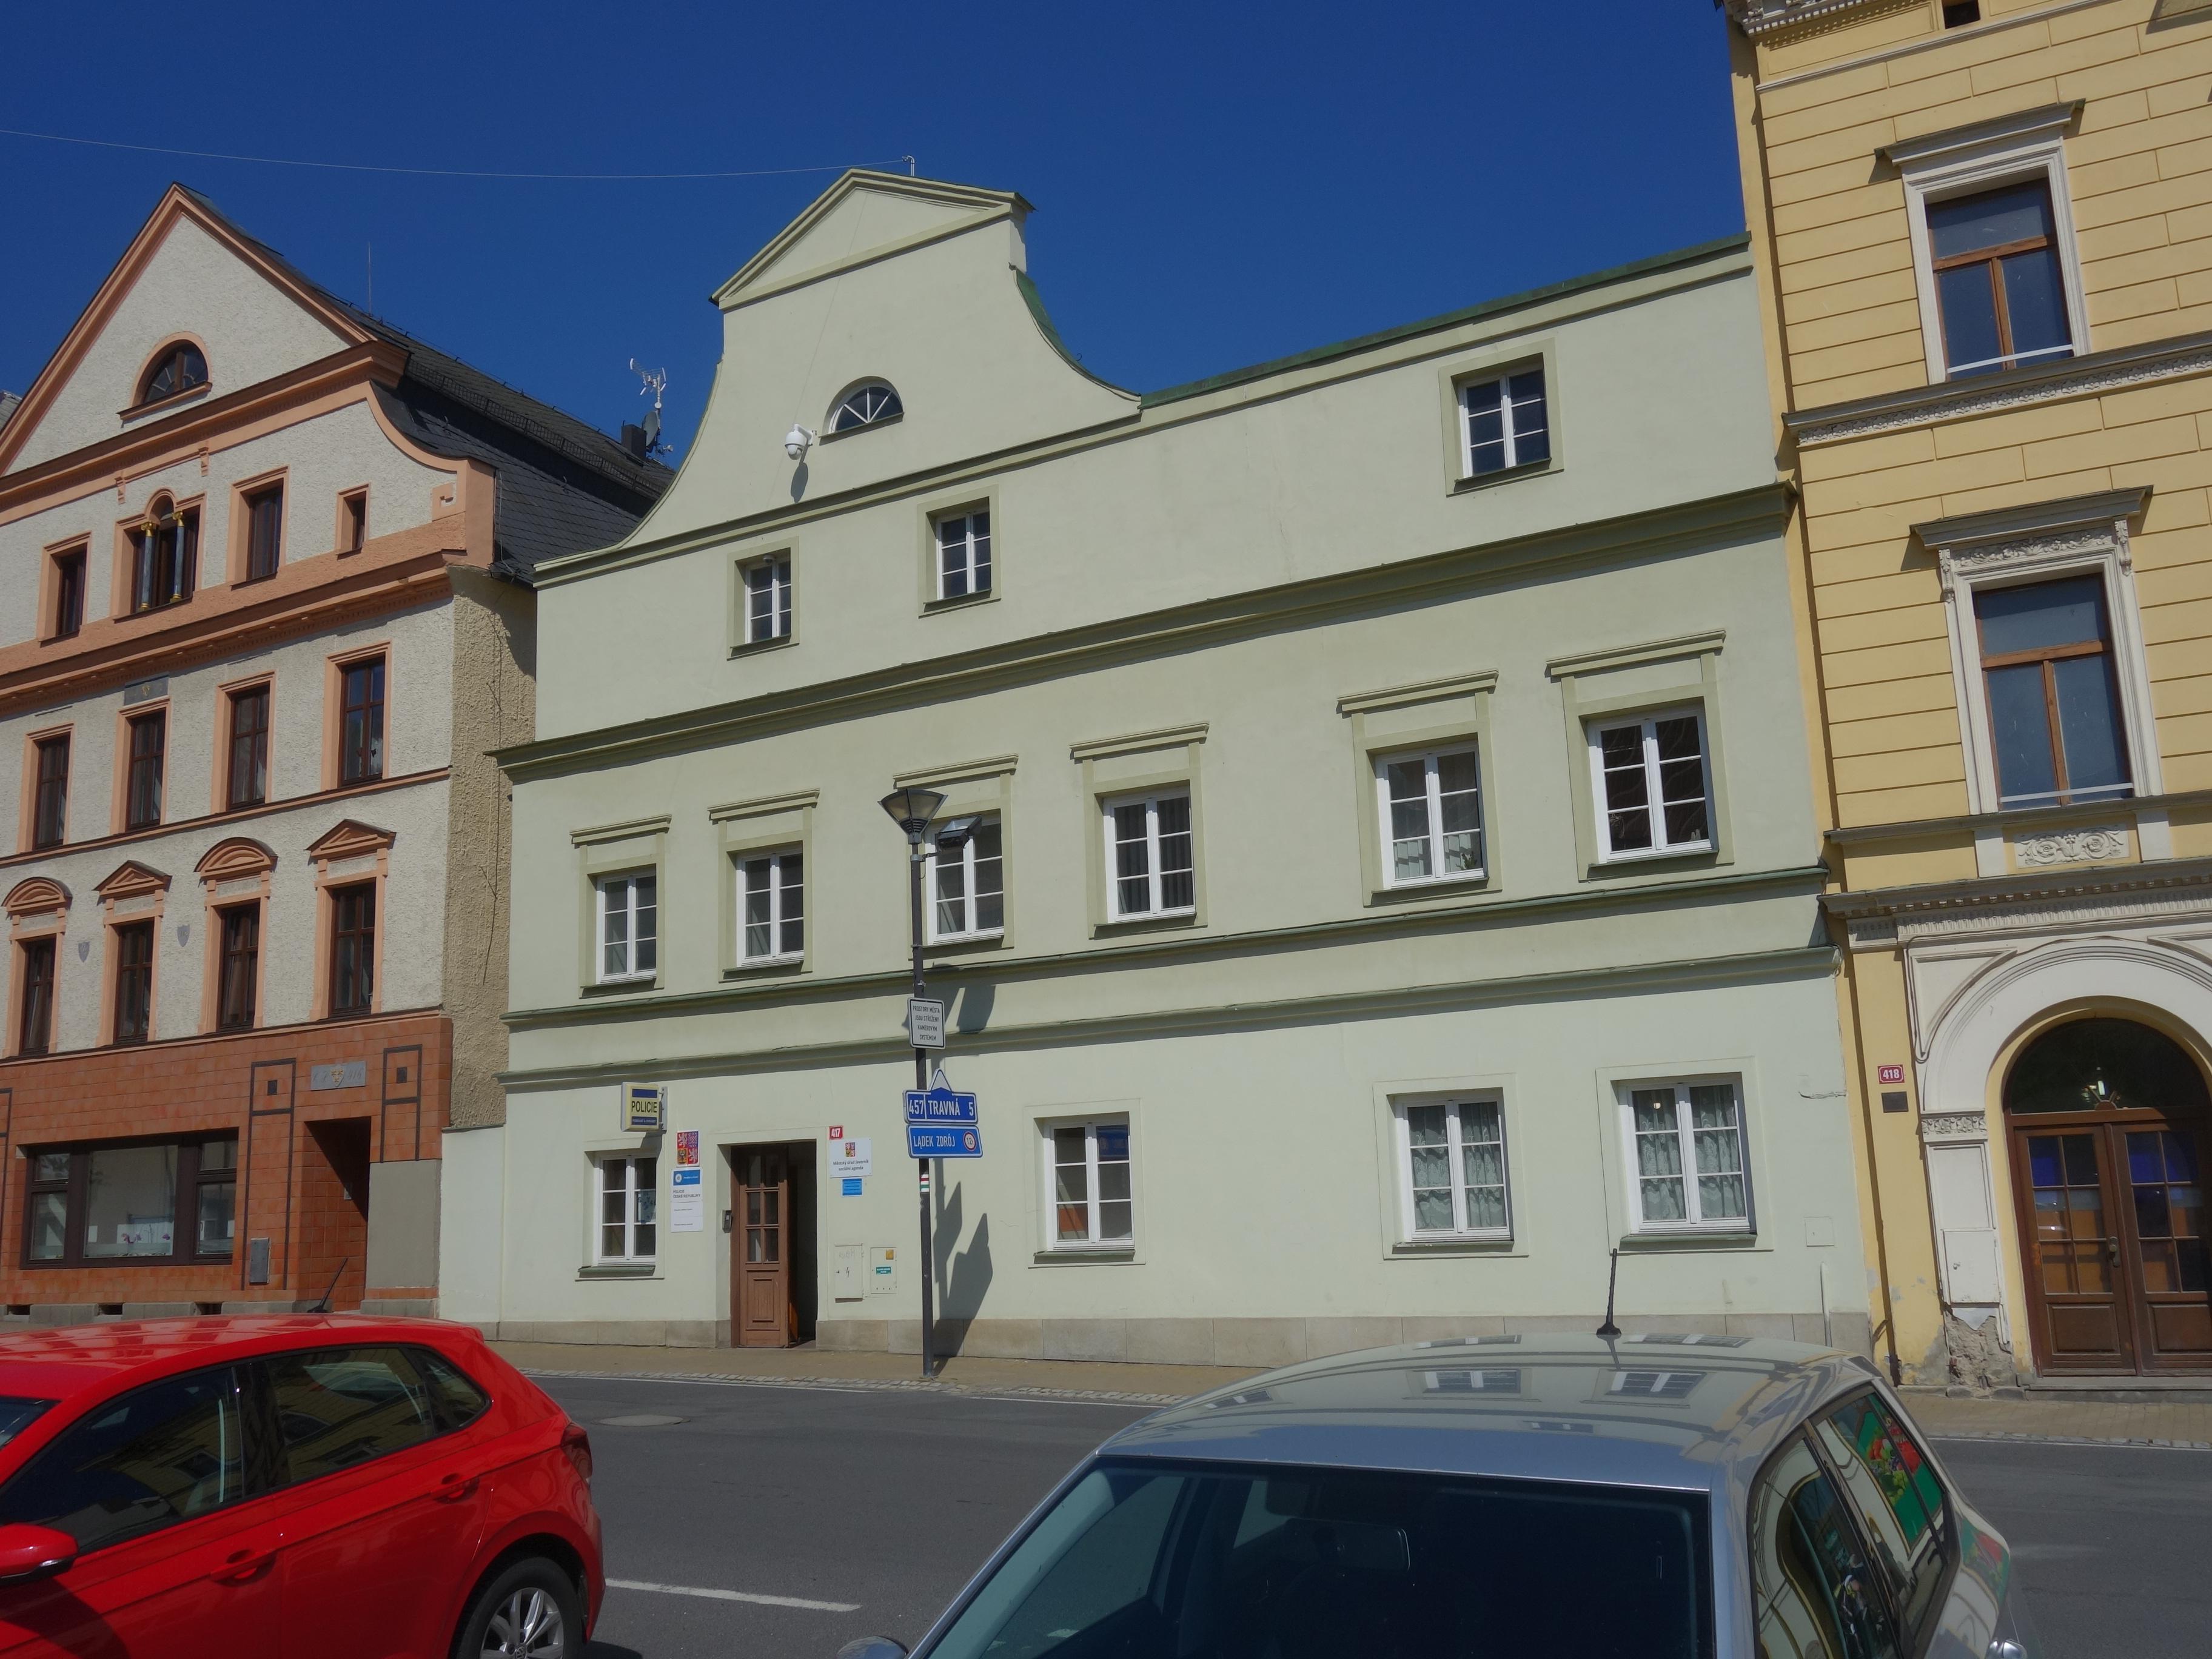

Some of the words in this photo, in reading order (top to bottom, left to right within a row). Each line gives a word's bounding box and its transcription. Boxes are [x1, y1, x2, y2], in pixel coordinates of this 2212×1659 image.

[1883, 1068, 1900, 1079] 418
[631, 1101, 657, 1113] POLICIE
[909, 1099, 924, 1115] 457
[928, 1098, 960, 1116] TRAVNÁ
[968, 1102, 974, 1116] 5
[831, 1128, 841, 1138] 417
[913, 1135, 934, 1150] LĄDEK
[936, 1133, 956, 1147] ZDRÓJ
